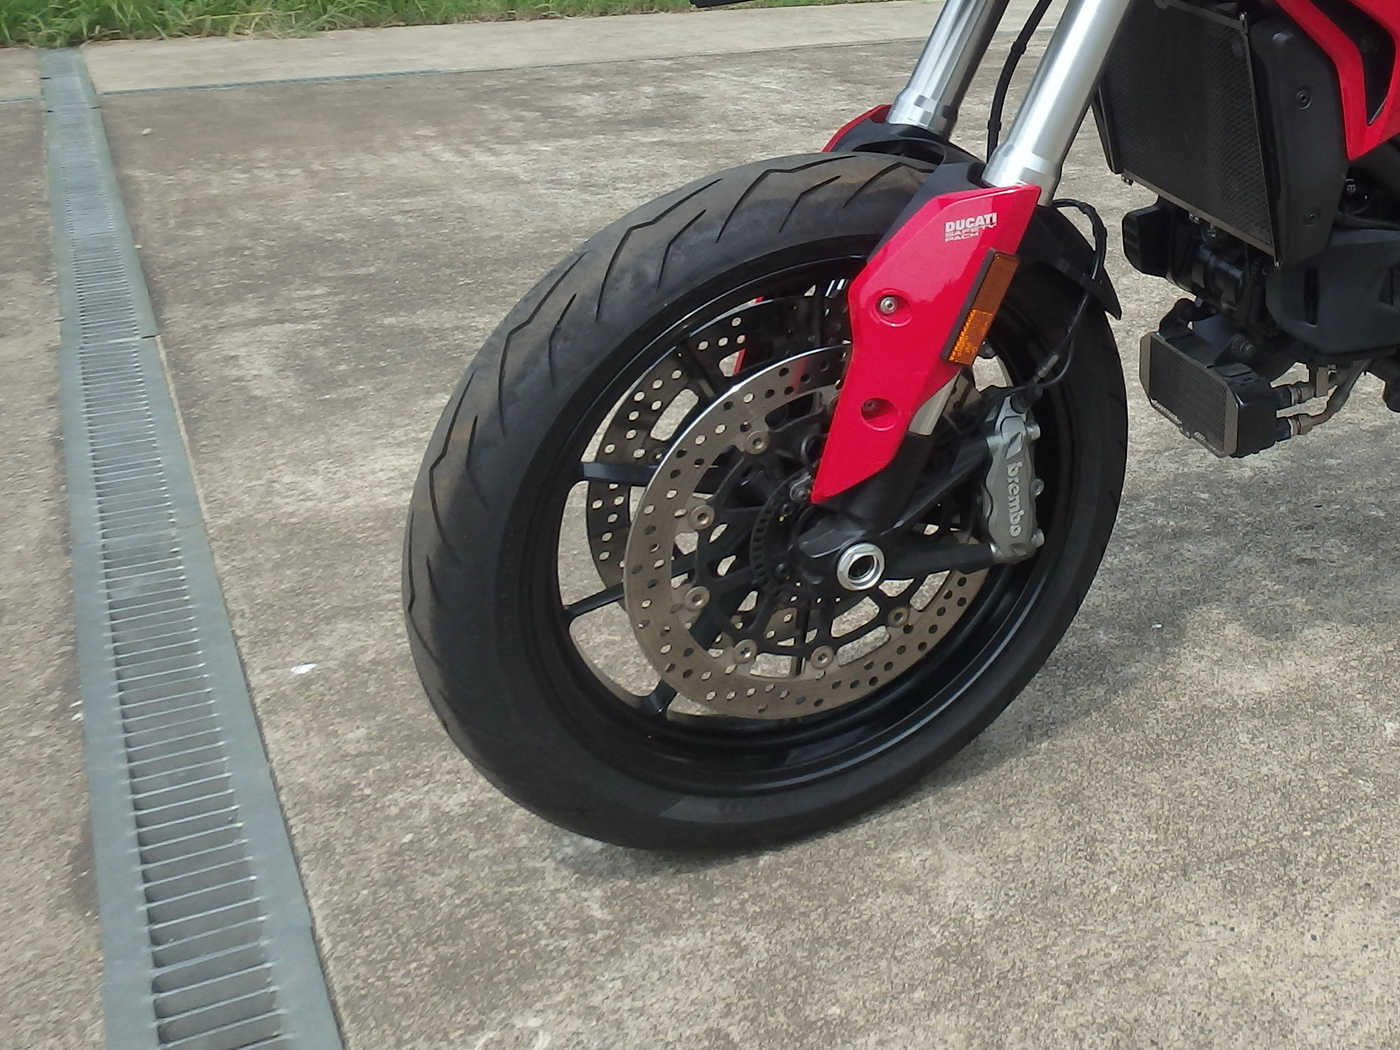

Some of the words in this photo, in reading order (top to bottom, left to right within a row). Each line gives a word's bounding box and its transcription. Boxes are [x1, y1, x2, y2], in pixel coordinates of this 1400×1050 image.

[945, 212, 997, 232] DUCATI
[945, 223, 997, 238] SAFETY
[1007, 462, 1025, 537] brembo
